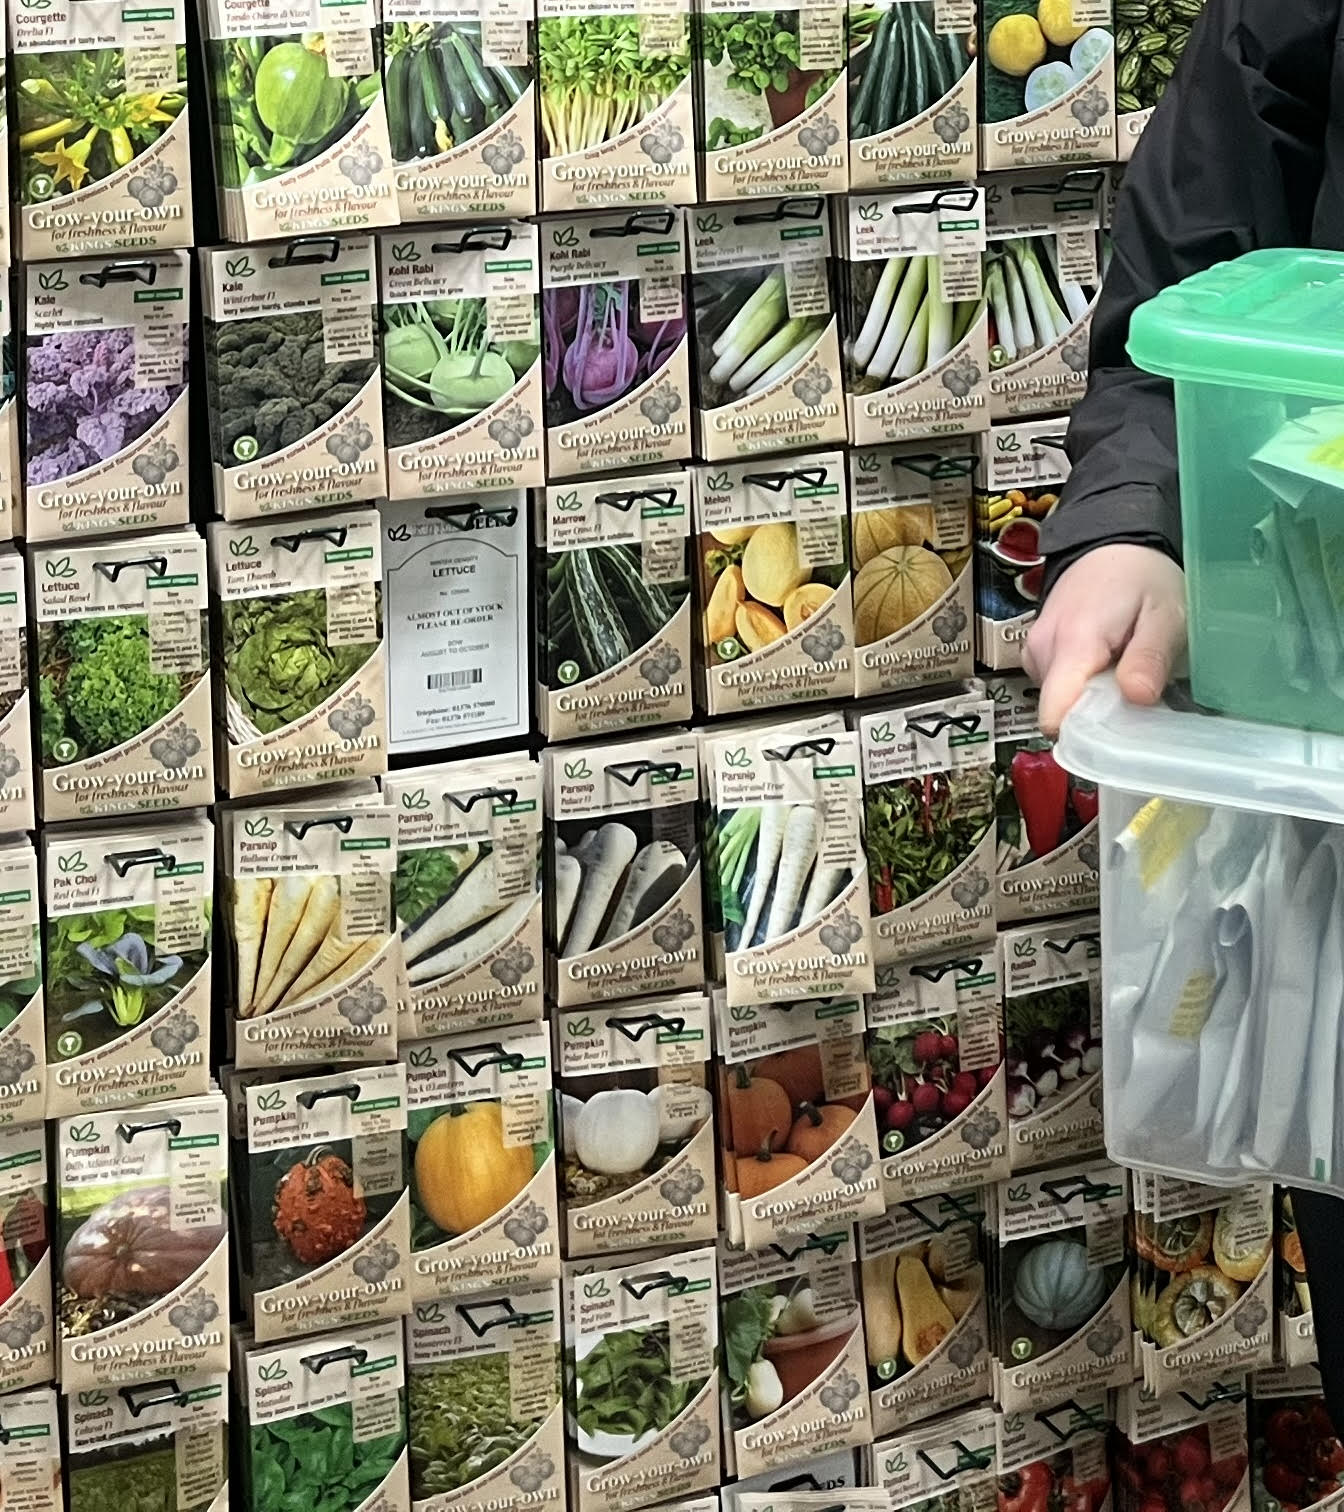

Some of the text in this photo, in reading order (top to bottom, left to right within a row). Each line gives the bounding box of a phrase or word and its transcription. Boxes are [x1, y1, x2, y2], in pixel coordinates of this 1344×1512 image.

[16, 12, 66, 25] Courgette
[389, 264, 434, 277] Kohl Rabi
[432, 565, 476, 578] LETTUCE
[42, 580, 80, 592] Lettuce
[240, 839, 277, 853] Parsnip
